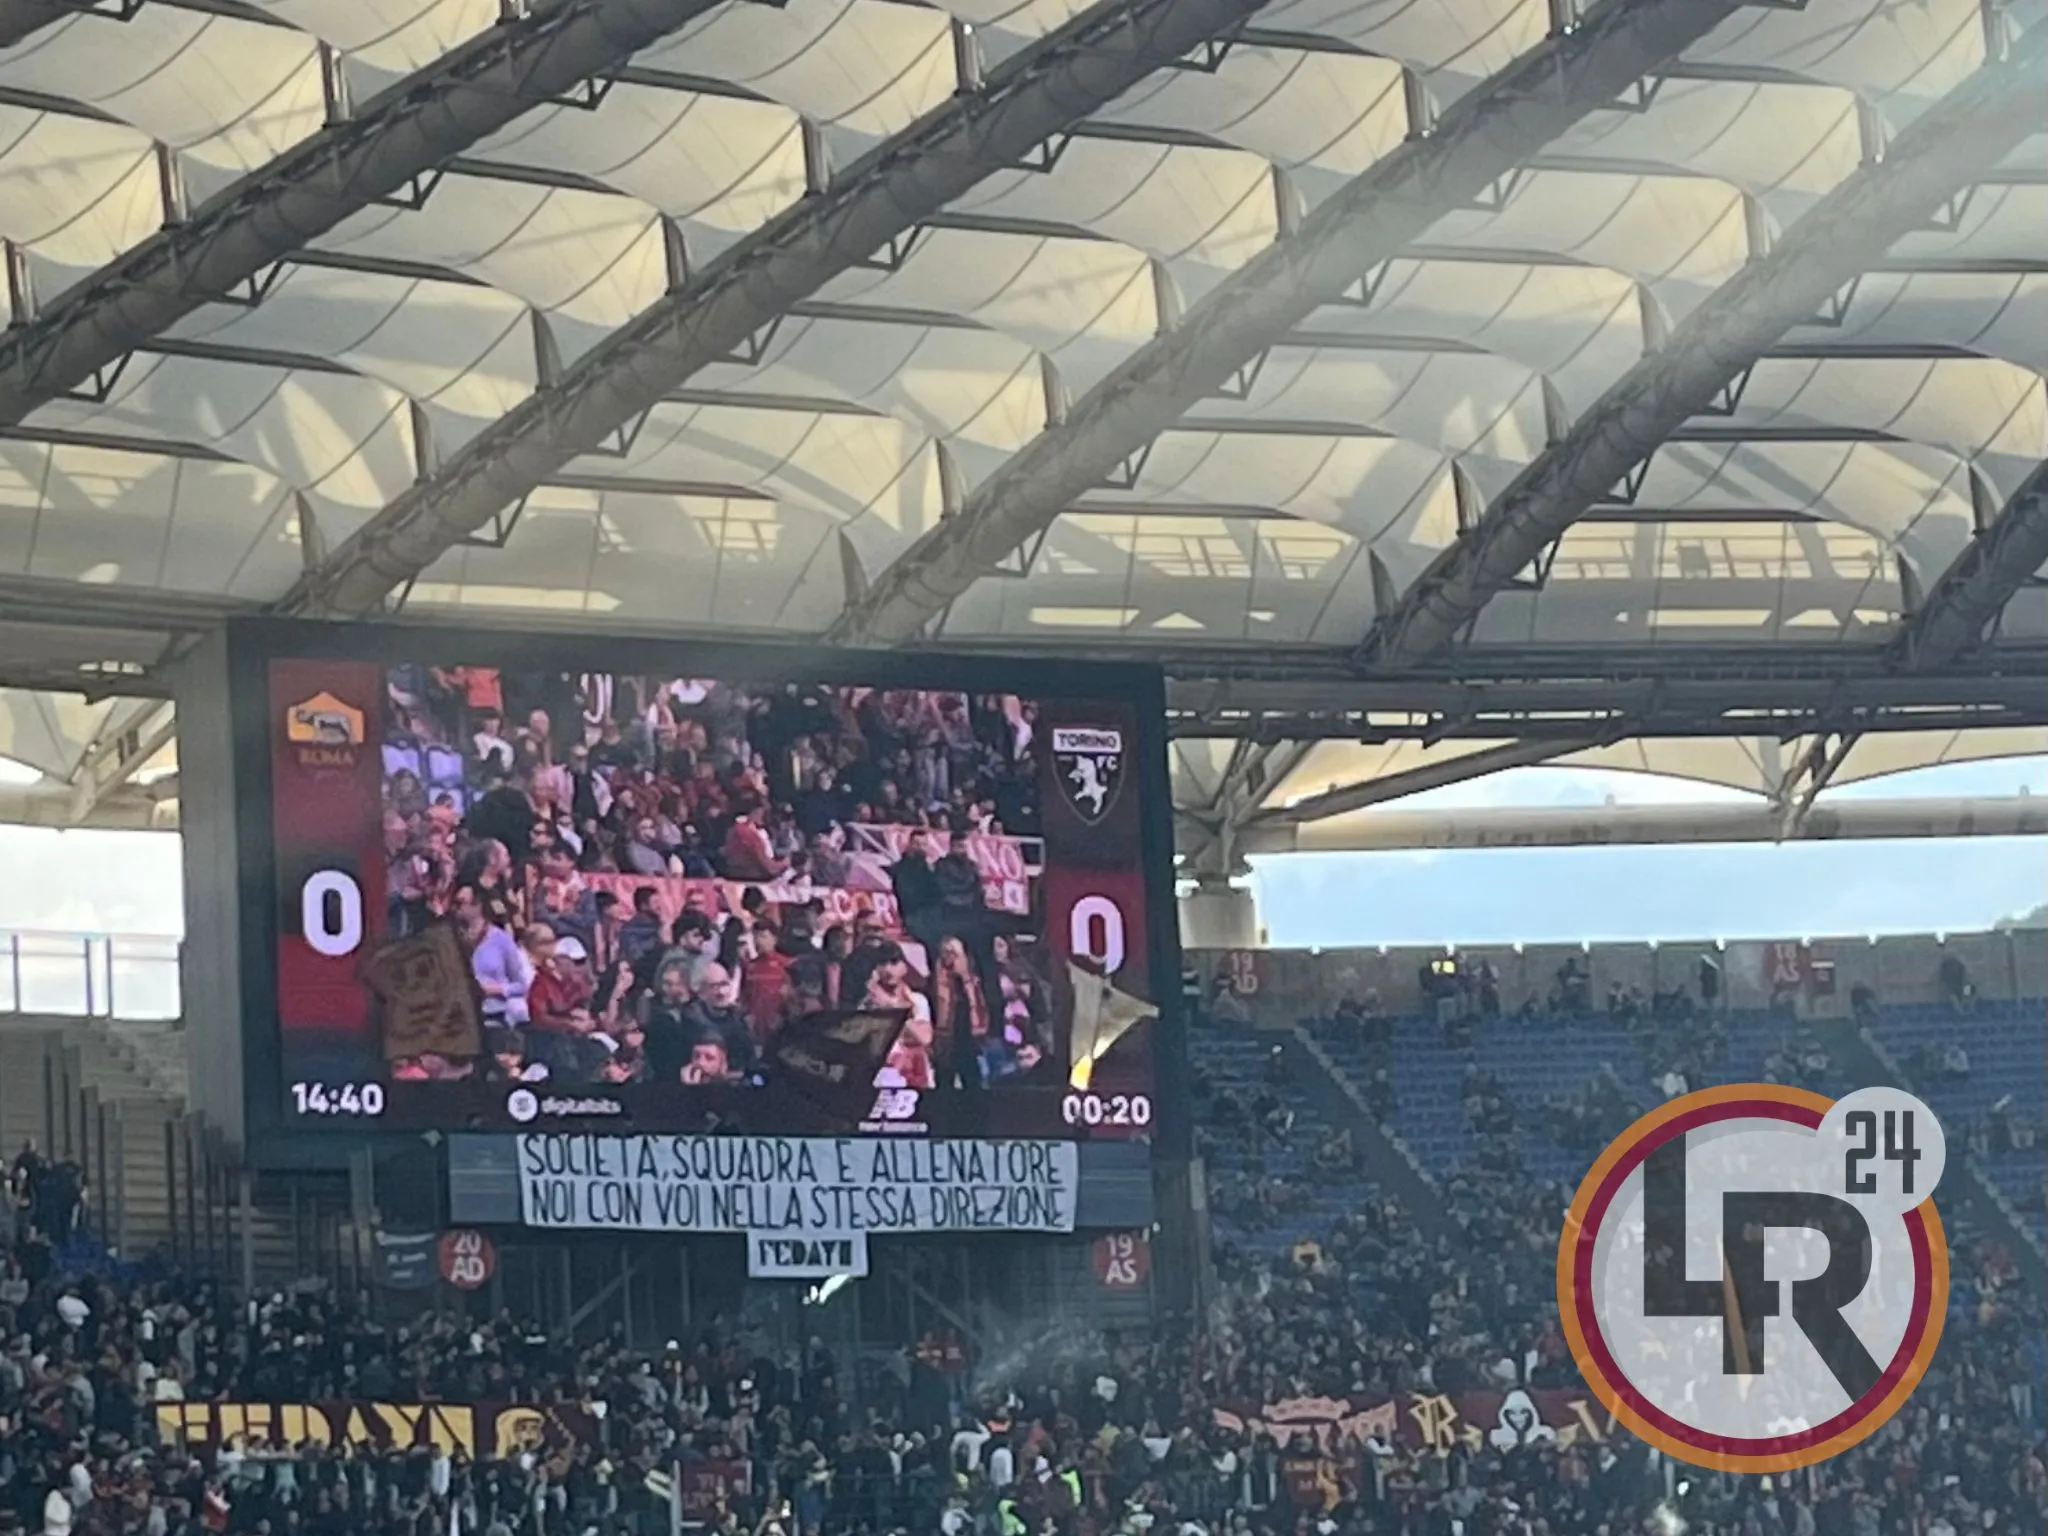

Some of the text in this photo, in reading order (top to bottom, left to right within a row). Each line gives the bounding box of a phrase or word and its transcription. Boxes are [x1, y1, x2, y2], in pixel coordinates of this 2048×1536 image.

[1058, 733, 1117, 748] TORINO
[303, 870, 362, 956] 0
[1071, 896, 1124, 975] 0
[292, 1083, 385, 1114] 14:40
[1063, 1096, 1151, 1125] 00:20
[672, 1136, 818, 1183] SQUADRA
[835, 1140, 855, 1183] E
[871, 1140, 1064, 1184] ALLENATORE
[531, 1179, 1067, 1230] NOI CON VOI NELLA STESSA DIREZIONE
[453, 1229, 483, 1255] 20
[1105, 1233, 1134, 1258] 19
[450, 1256, 486, 1284] AD
[1105, 1259, 1138, 1285] AS
[156, 1403, 477, 1461] FEDAYN
